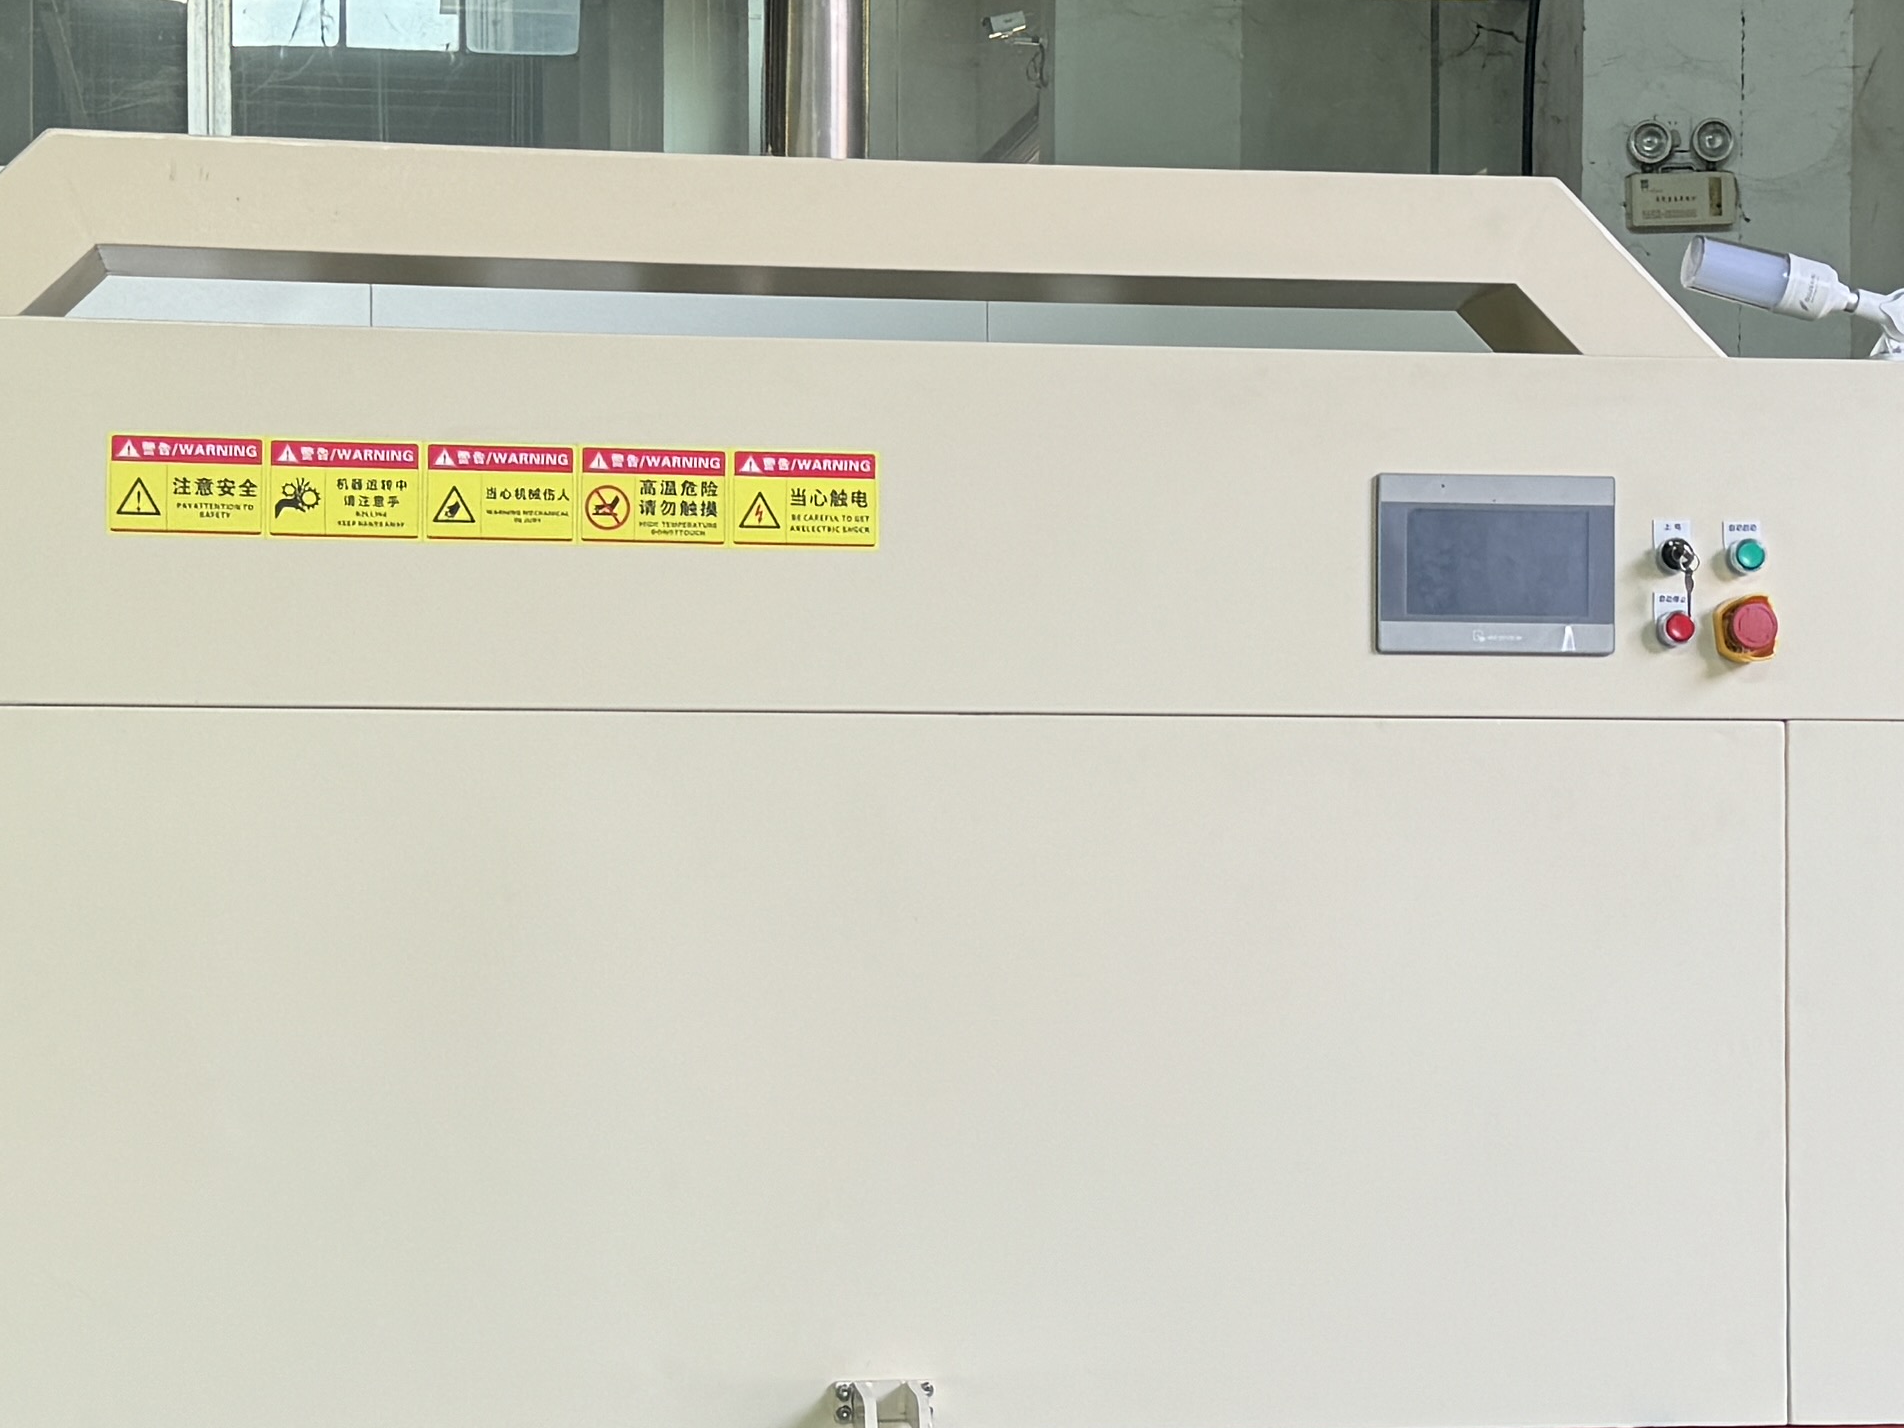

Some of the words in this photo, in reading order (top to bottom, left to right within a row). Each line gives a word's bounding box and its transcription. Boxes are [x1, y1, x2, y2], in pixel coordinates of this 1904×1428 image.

[172, 476, 257, 497] 注意安全
[639, 479, 718, 497] 高温危险
[790, 487, 869, 508] 当心触电
[639, 499, 718, 518] 请勿触摸
[842, 514, 853, 522] TO
